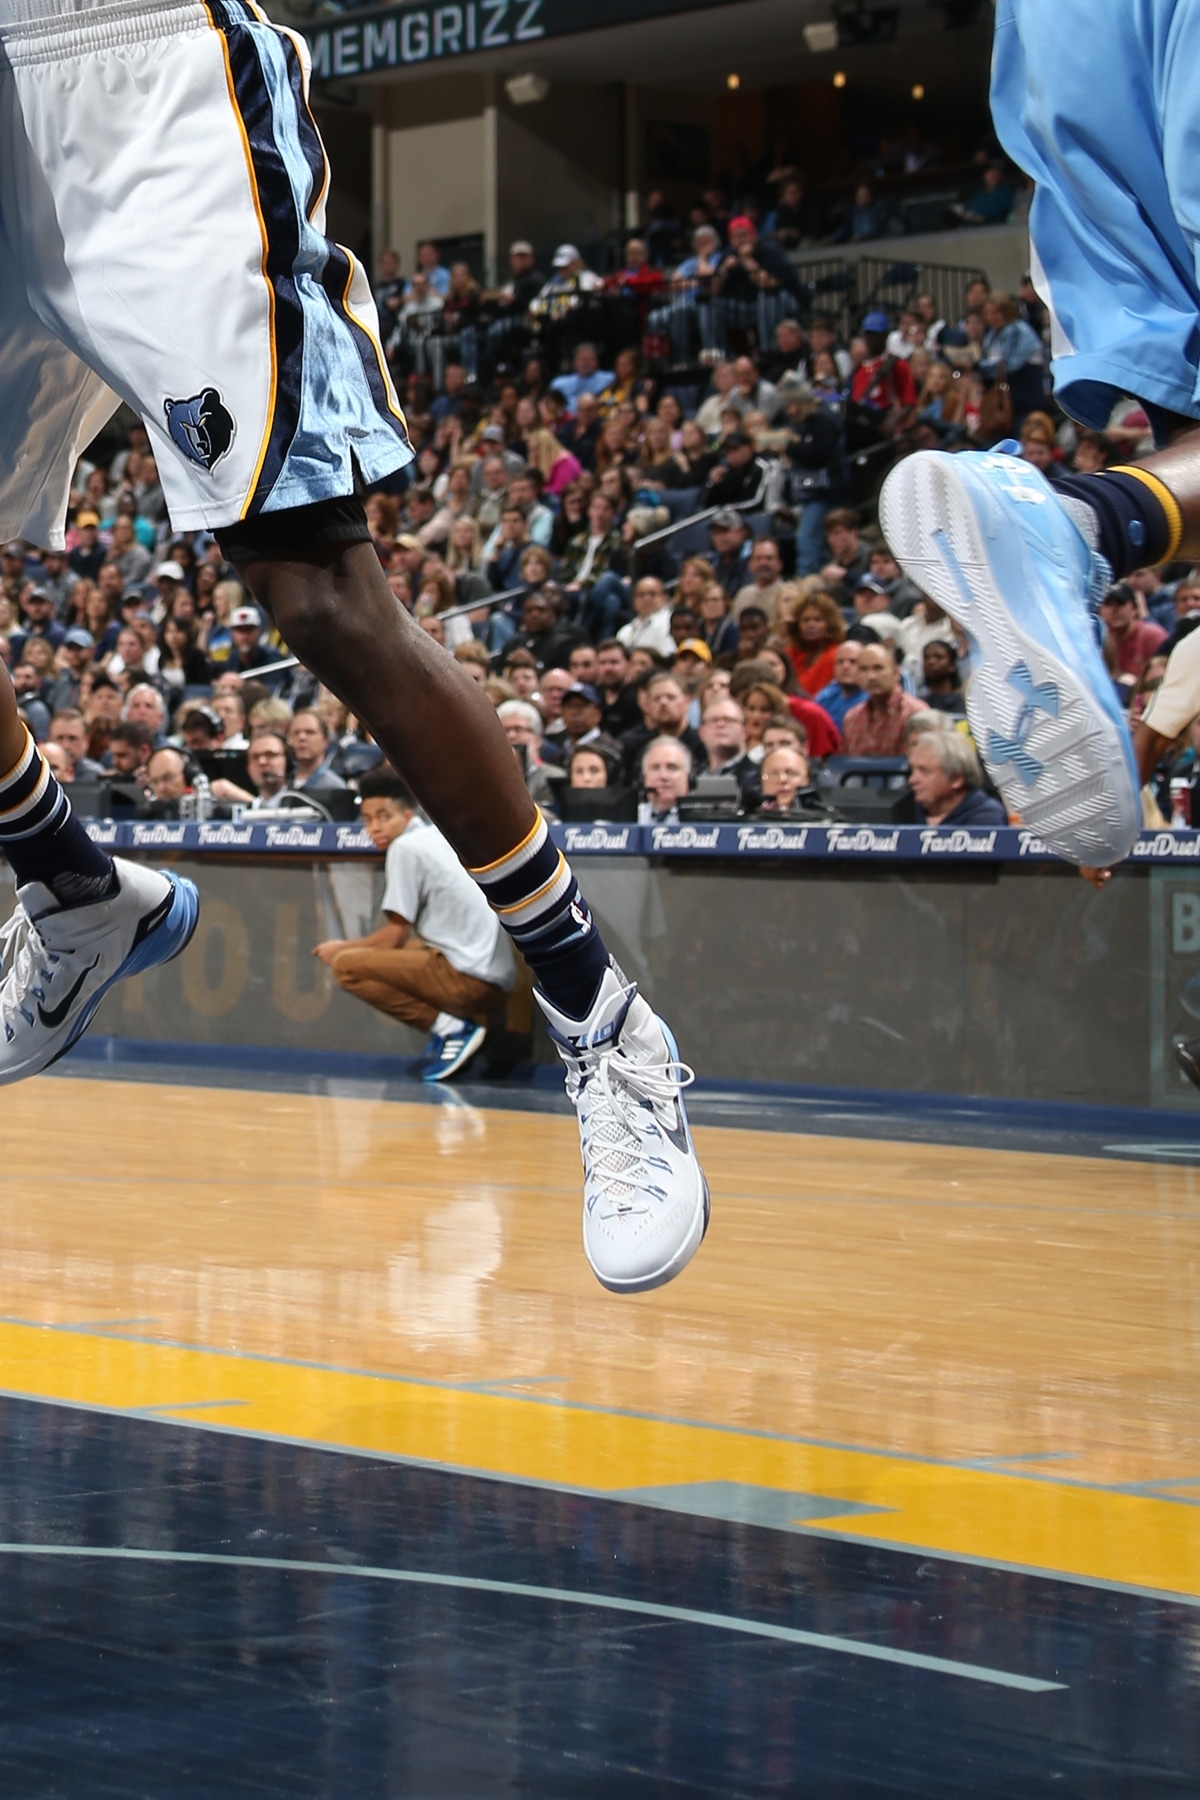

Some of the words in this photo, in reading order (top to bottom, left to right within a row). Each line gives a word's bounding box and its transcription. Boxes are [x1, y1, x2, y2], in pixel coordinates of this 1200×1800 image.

[133, 823, 186, 845] FanDuel
[198, 825, 252, 845] FanDuel
[266, 824, 323, 847] FanDuel
[564, 827, 629, 850] FanDuel
[652, 826, 720, 850] FanDuel
[737, 827, 808, 851] FanDuel
[826, 829, 899, 853] FanDuel
[919, 829, 997, 855] FanDuel
[1132, 833, 1200, 857] anDuel
